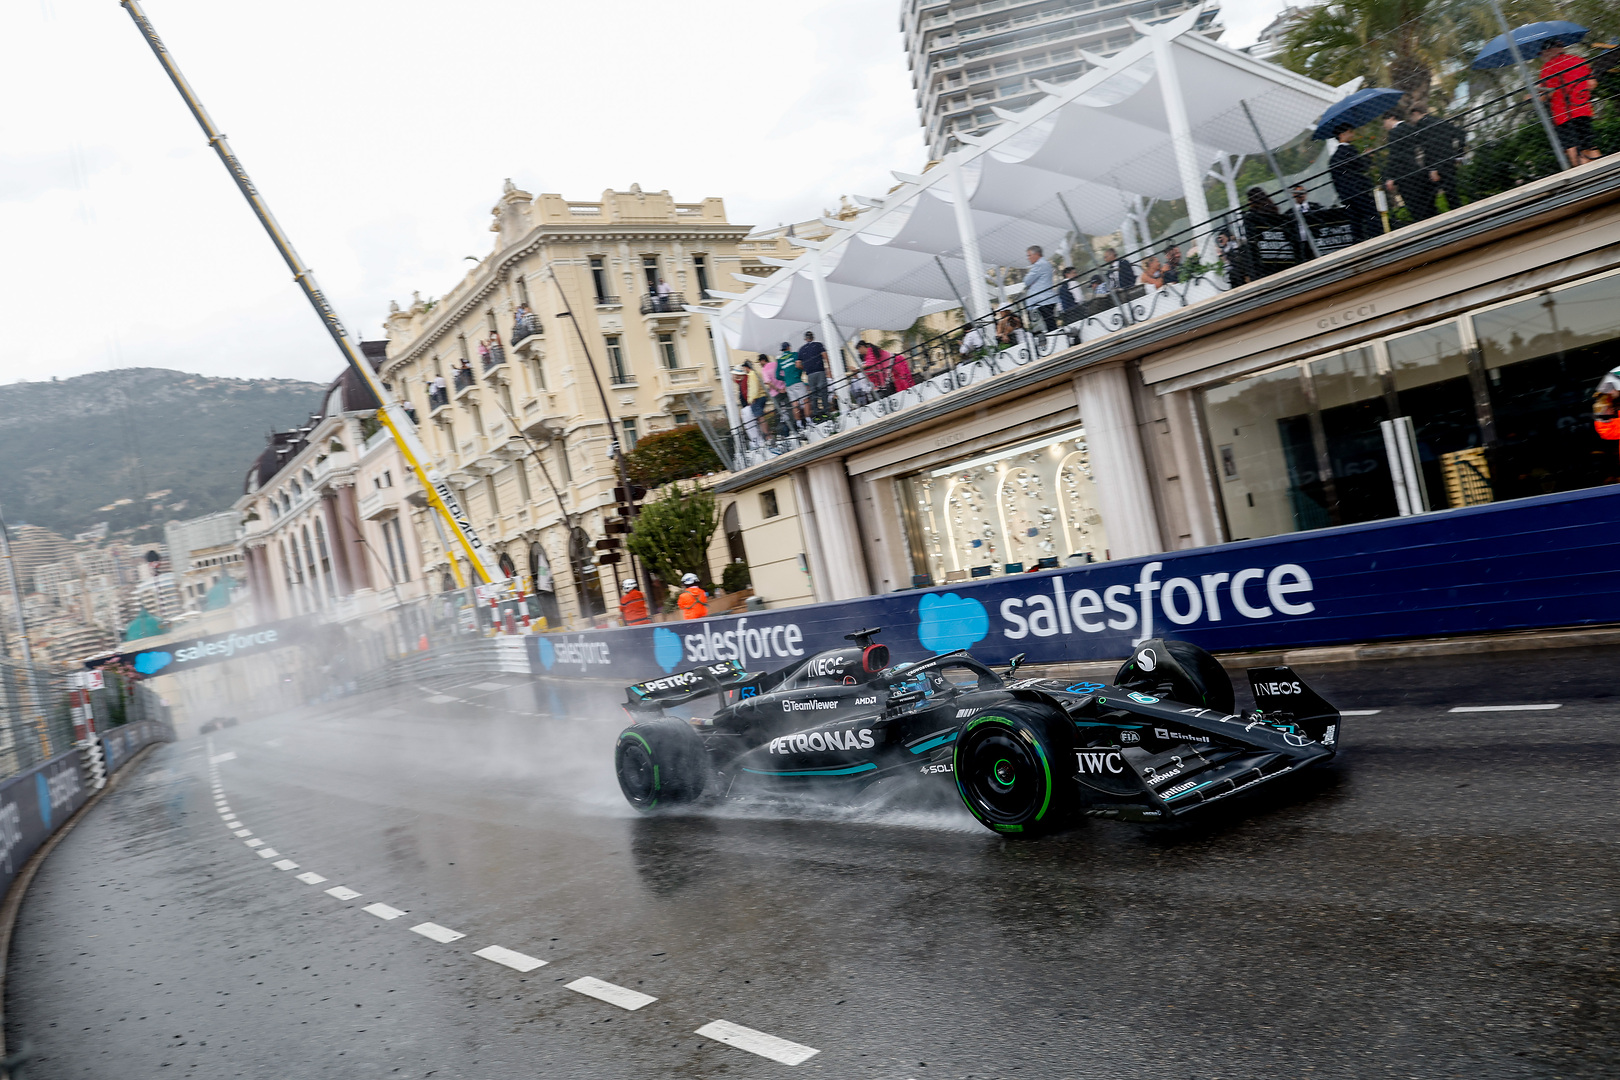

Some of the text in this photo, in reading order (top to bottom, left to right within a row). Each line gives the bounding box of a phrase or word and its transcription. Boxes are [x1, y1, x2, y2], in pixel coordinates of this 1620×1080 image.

[1316, 303, 1377, 329] GUCCI
[1000, 561, 1316, 646] salesforce
[174, 629, 278, 663] salesforce
[684, 617, 804, 671] salesforce
[644, 663, 729, 692] PETROAS
[1254, 681, 1302, 696] INEOS
[741, 686, 757, 700] 63
[855, 697, 871, 705] AMD
[790, 699, 838, 711] TeamViewer
[769, 728, 875, 755] PETRONAS
[1121, 731, 1139, 743] FIA
[1075, 752, 1124, 774] IWC
[1146, 768, 1181, 787] TRONAS
